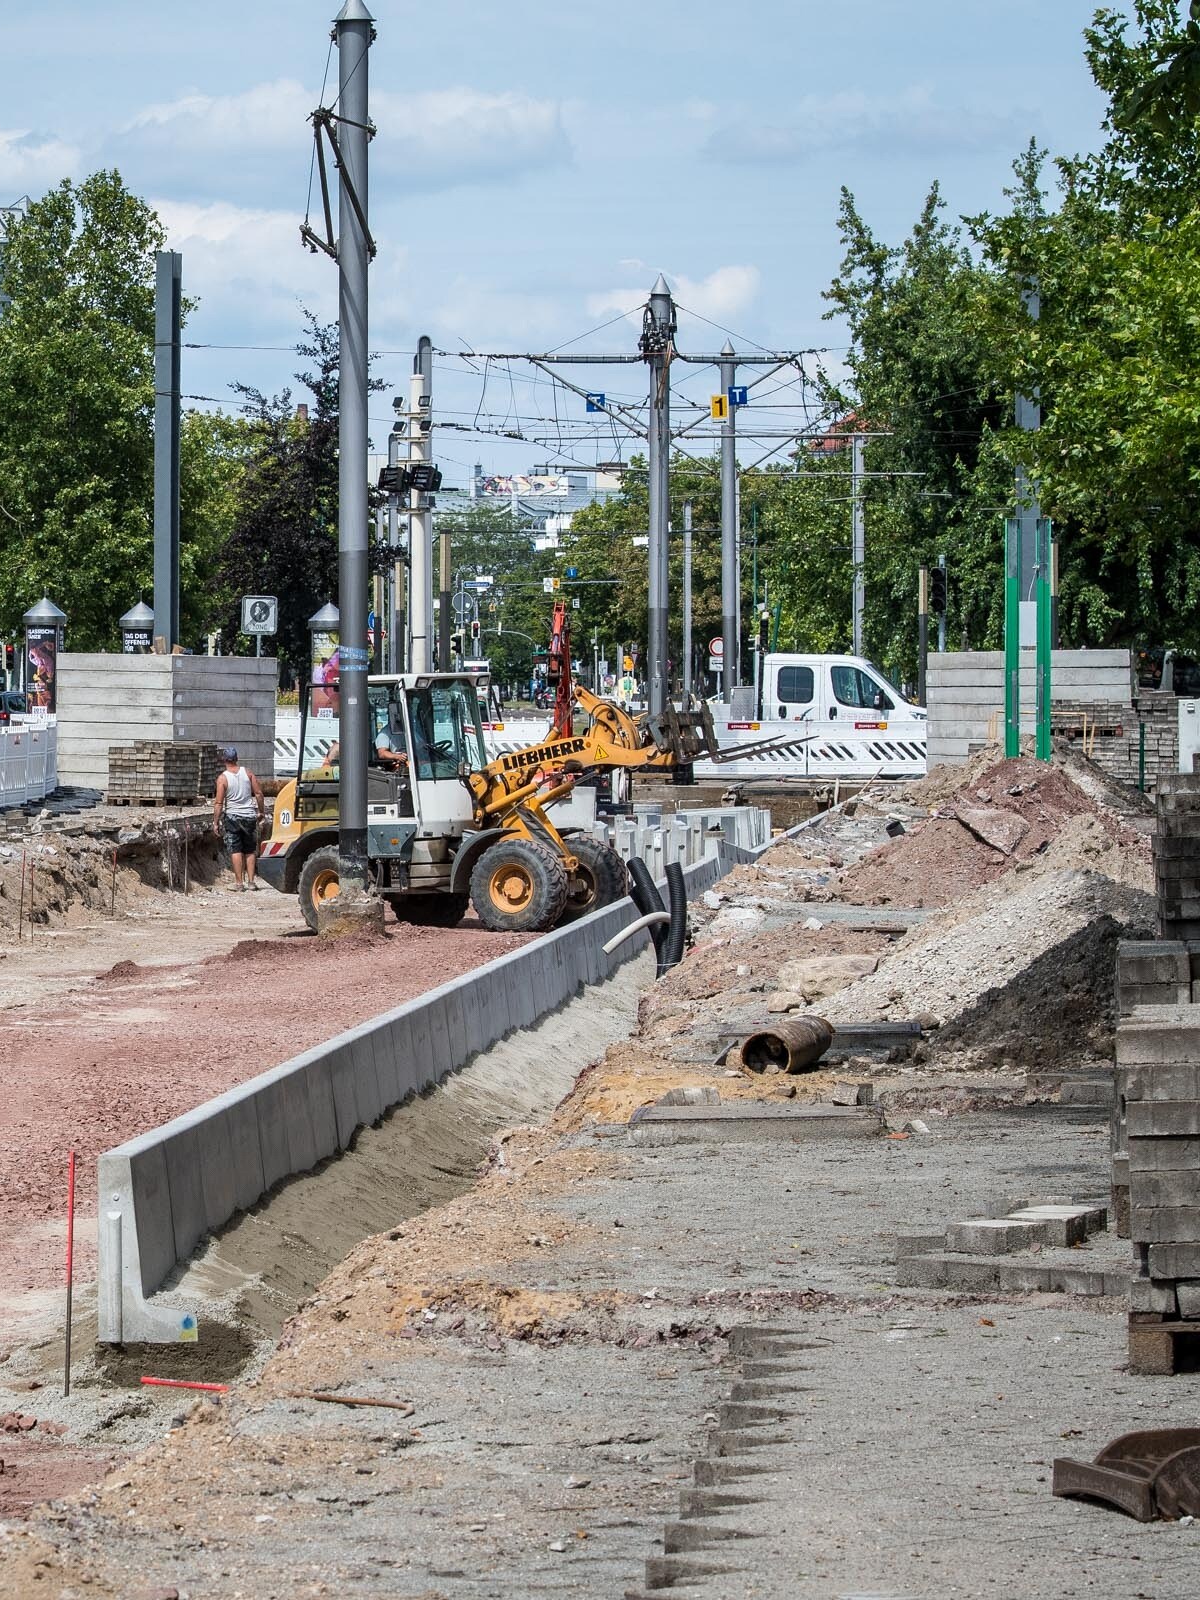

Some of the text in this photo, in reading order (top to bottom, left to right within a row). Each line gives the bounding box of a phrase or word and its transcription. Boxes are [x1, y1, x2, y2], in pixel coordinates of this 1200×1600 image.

[732, 389, 743, 402] T
[715, 398, 724, 416] 1
[503, 739, 587, 771] LIEBHERR
[281, 812, 290, 825] 20
